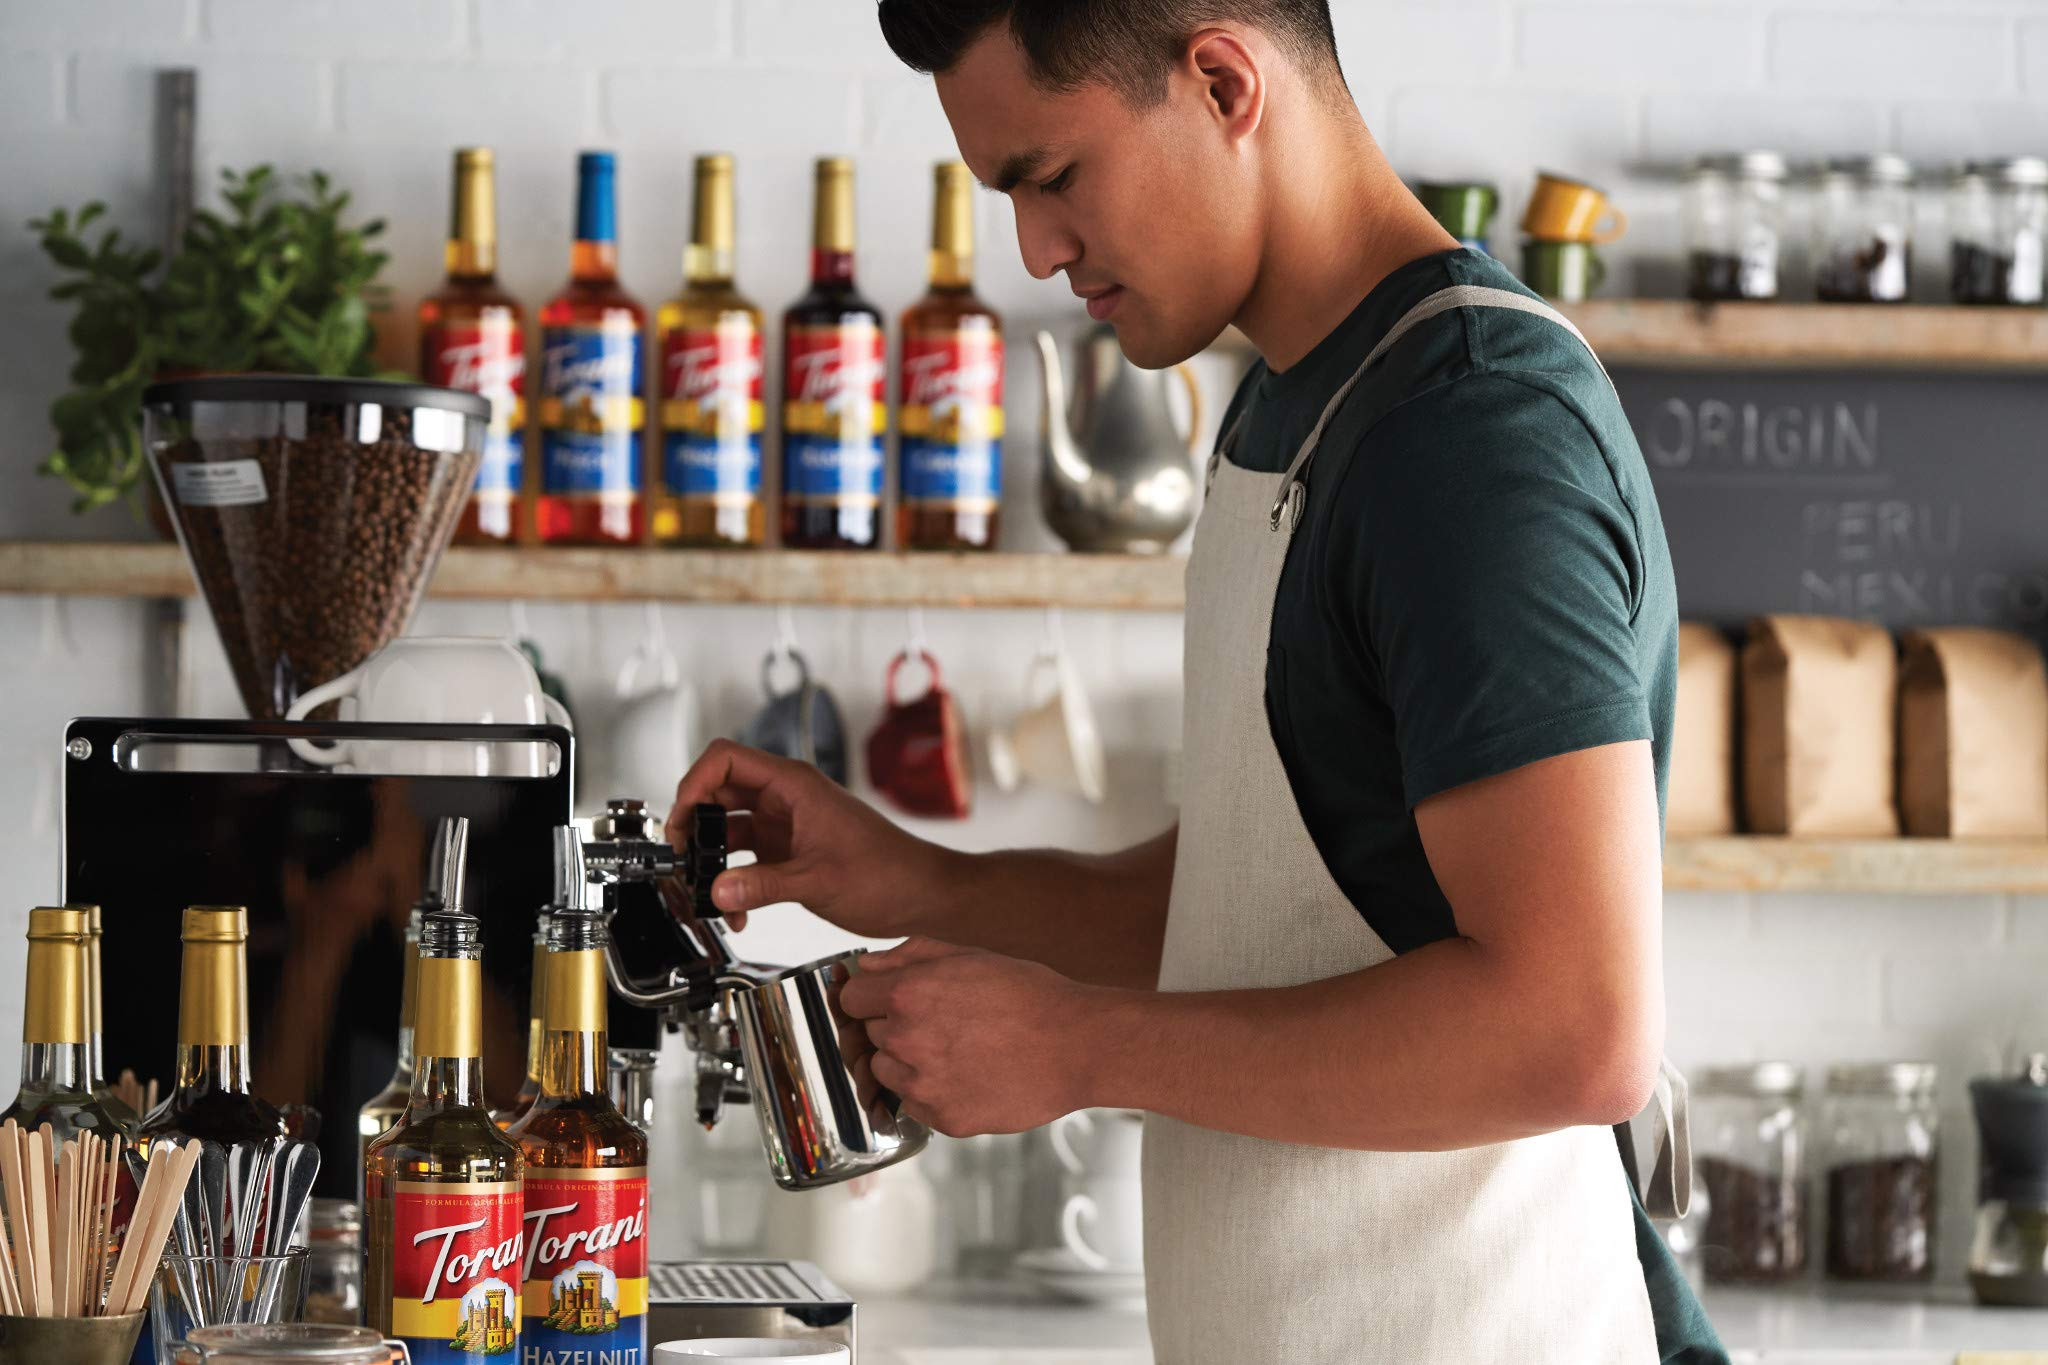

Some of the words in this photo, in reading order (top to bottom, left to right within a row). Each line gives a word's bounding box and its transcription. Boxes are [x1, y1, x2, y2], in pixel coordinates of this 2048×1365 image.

[1648, 397, 1879, 468] ORIGIN
[1801, 500, 1963, 561] PERU
[414, 1217, 523, 1304] Toran
[522, 1198, 645, 1281] Torani
